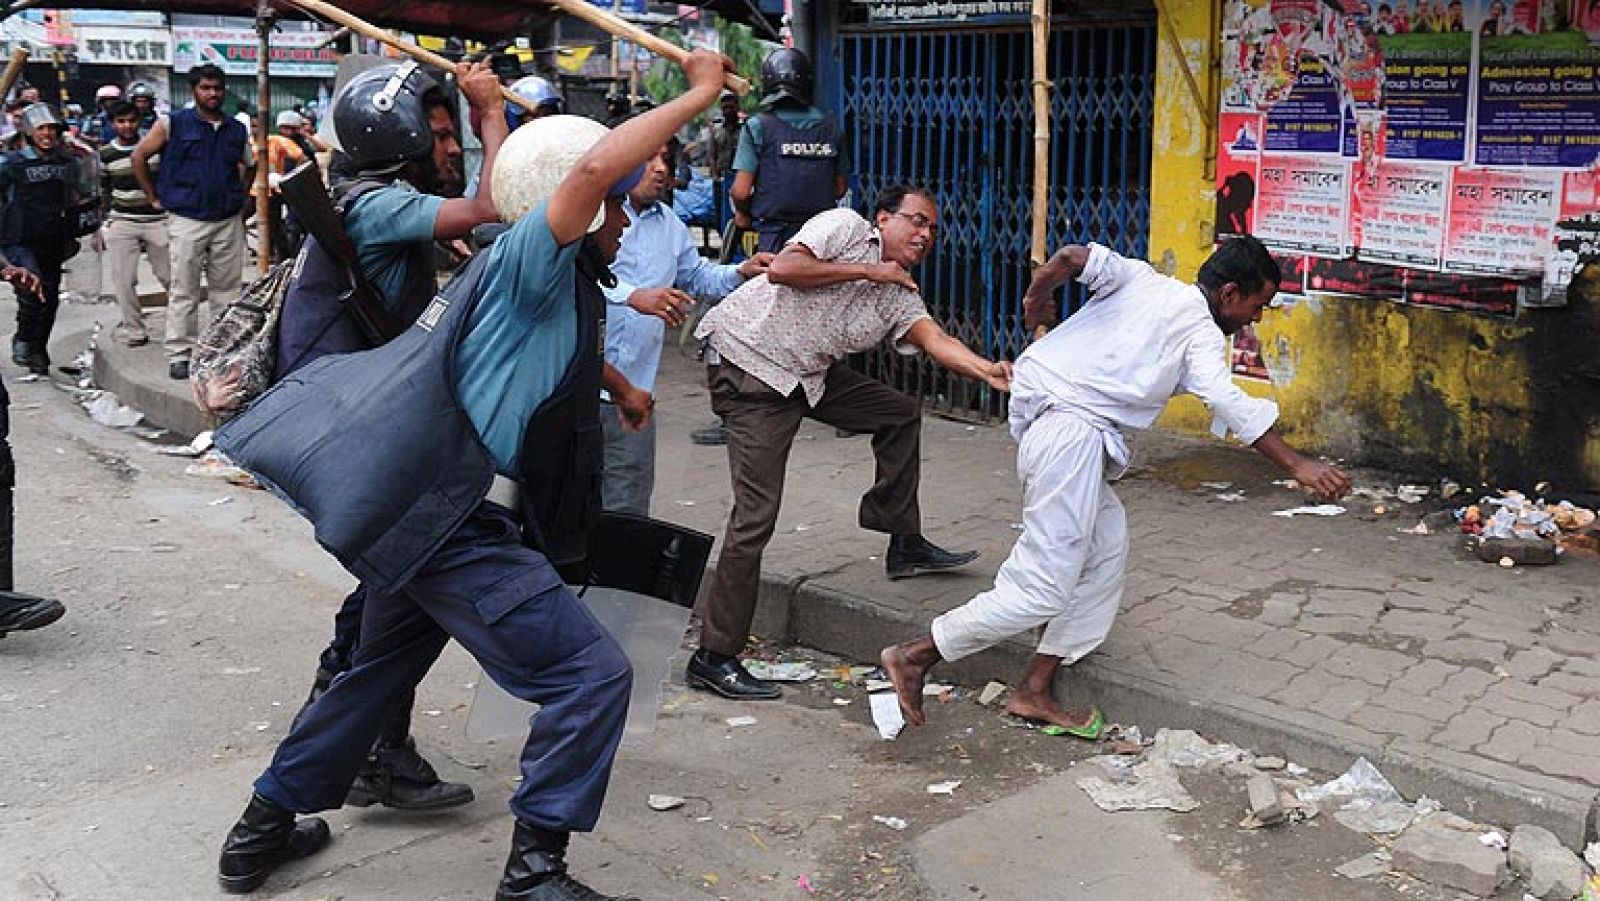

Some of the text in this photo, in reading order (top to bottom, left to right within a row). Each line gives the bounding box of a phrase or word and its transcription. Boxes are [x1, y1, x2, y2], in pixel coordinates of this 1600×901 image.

[1414, 63, 1448, 77] going
[1451, 66, 1467, 75] on
[1481, 66, 1593, 80] Admission going
[1423, 79, 1449, 90] Class
[1489, 81, 1594, 93] Play Group to Class
[1261, 168, 1286, 184] মহা
[1291, 170, 1343, 188] সমাবেশ
[1386, 176, 1442, 196] সমাবেশ
[1456, 185, 1553, 206] মহা সমাবেশ
